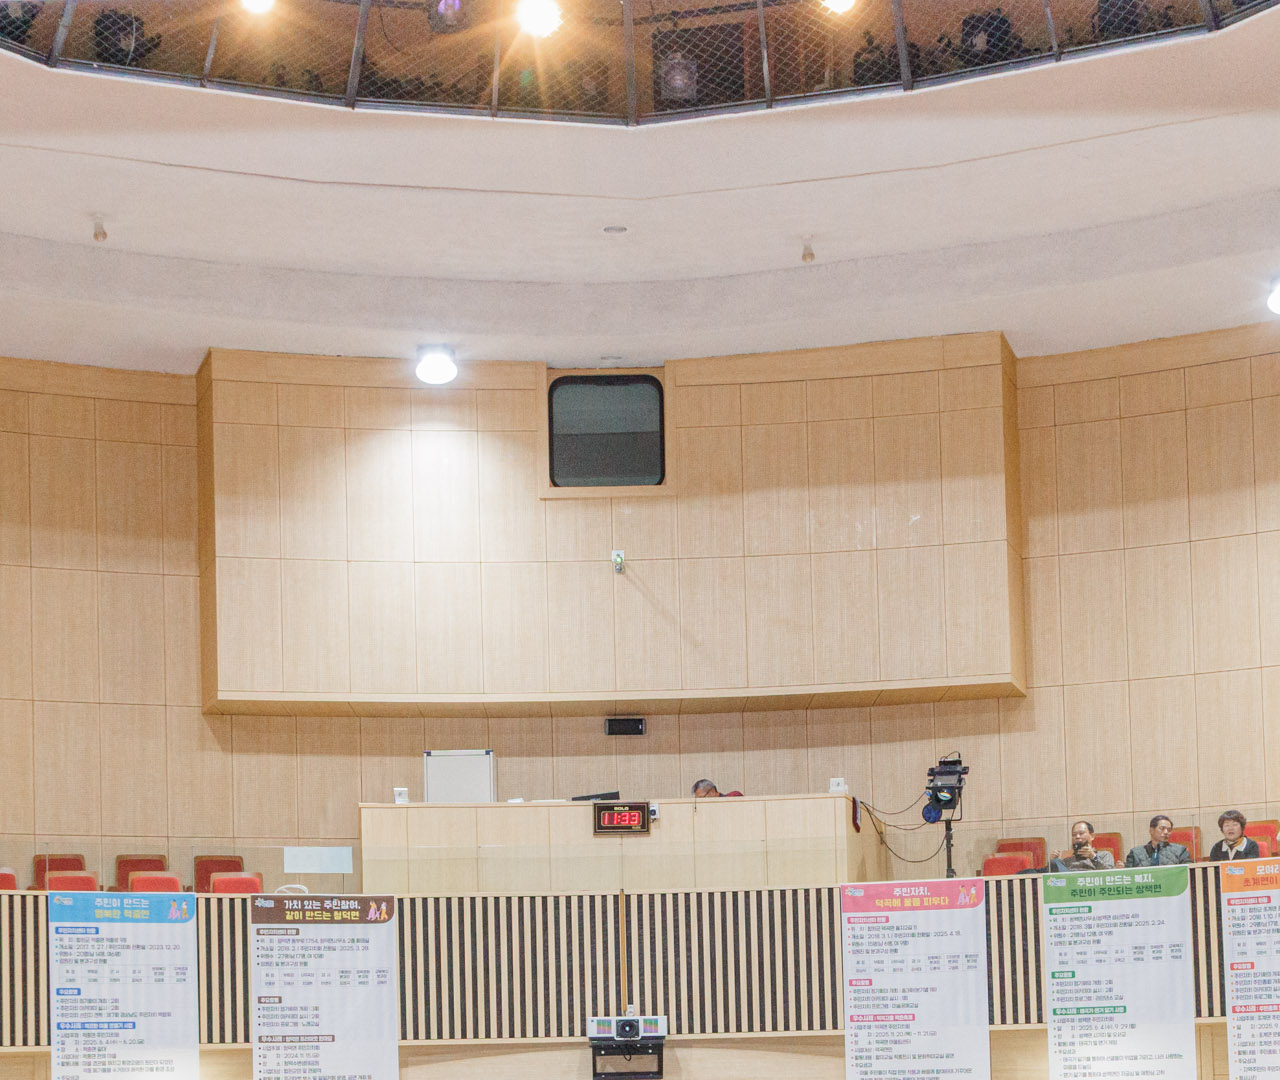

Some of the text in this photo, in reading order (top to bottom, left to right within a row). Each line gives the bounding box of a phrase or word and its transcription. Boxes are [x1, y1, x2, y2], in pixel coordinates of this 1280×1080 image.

[604, 813, 639, 824] 11:33
[1077, 875, 1131, 886] 주민이 만드는
[1071, 884, 1162, 897] 주민이 주인되는 쌍책면
[284, 900, 301, 909] 가치
[304, 900, 321, 909] 있는
[285, 911, 302, 920] 같이
[306, 911, 331, 920] 만드는
